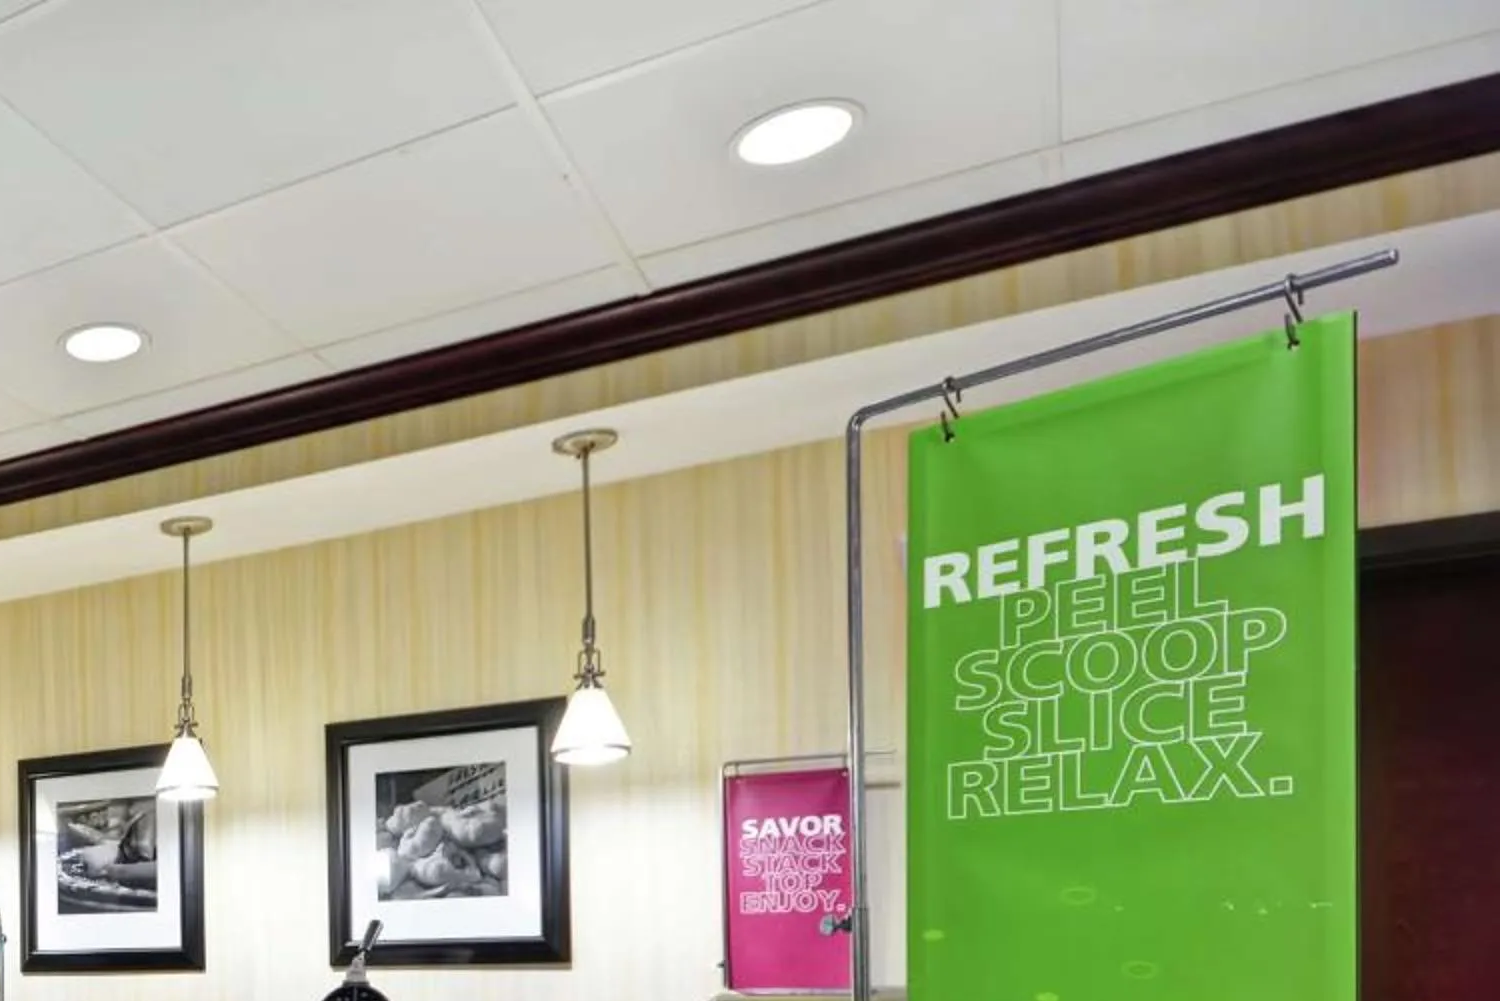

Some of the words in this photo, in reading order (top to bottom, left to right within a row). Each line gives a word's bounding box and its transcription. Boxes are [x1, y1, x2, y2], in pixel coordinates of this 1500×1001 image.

[923, 473, 1325, 609] REFRESH
[1001, 556, 1228, 650] PEEL
[954, 606, 1287, 711] SCOOP
[982, 671, 1248, 763] SLICE
[947, 731, 1294, 820] RELAX.
[740, 832, 846, 858] SNACK
[741, 815, 844, 838] SAVOR
[742, 852, 842, 876] STACK
[762, 871, 824, 894] TOP
[740, 889, 847, 914] ENJOY.
